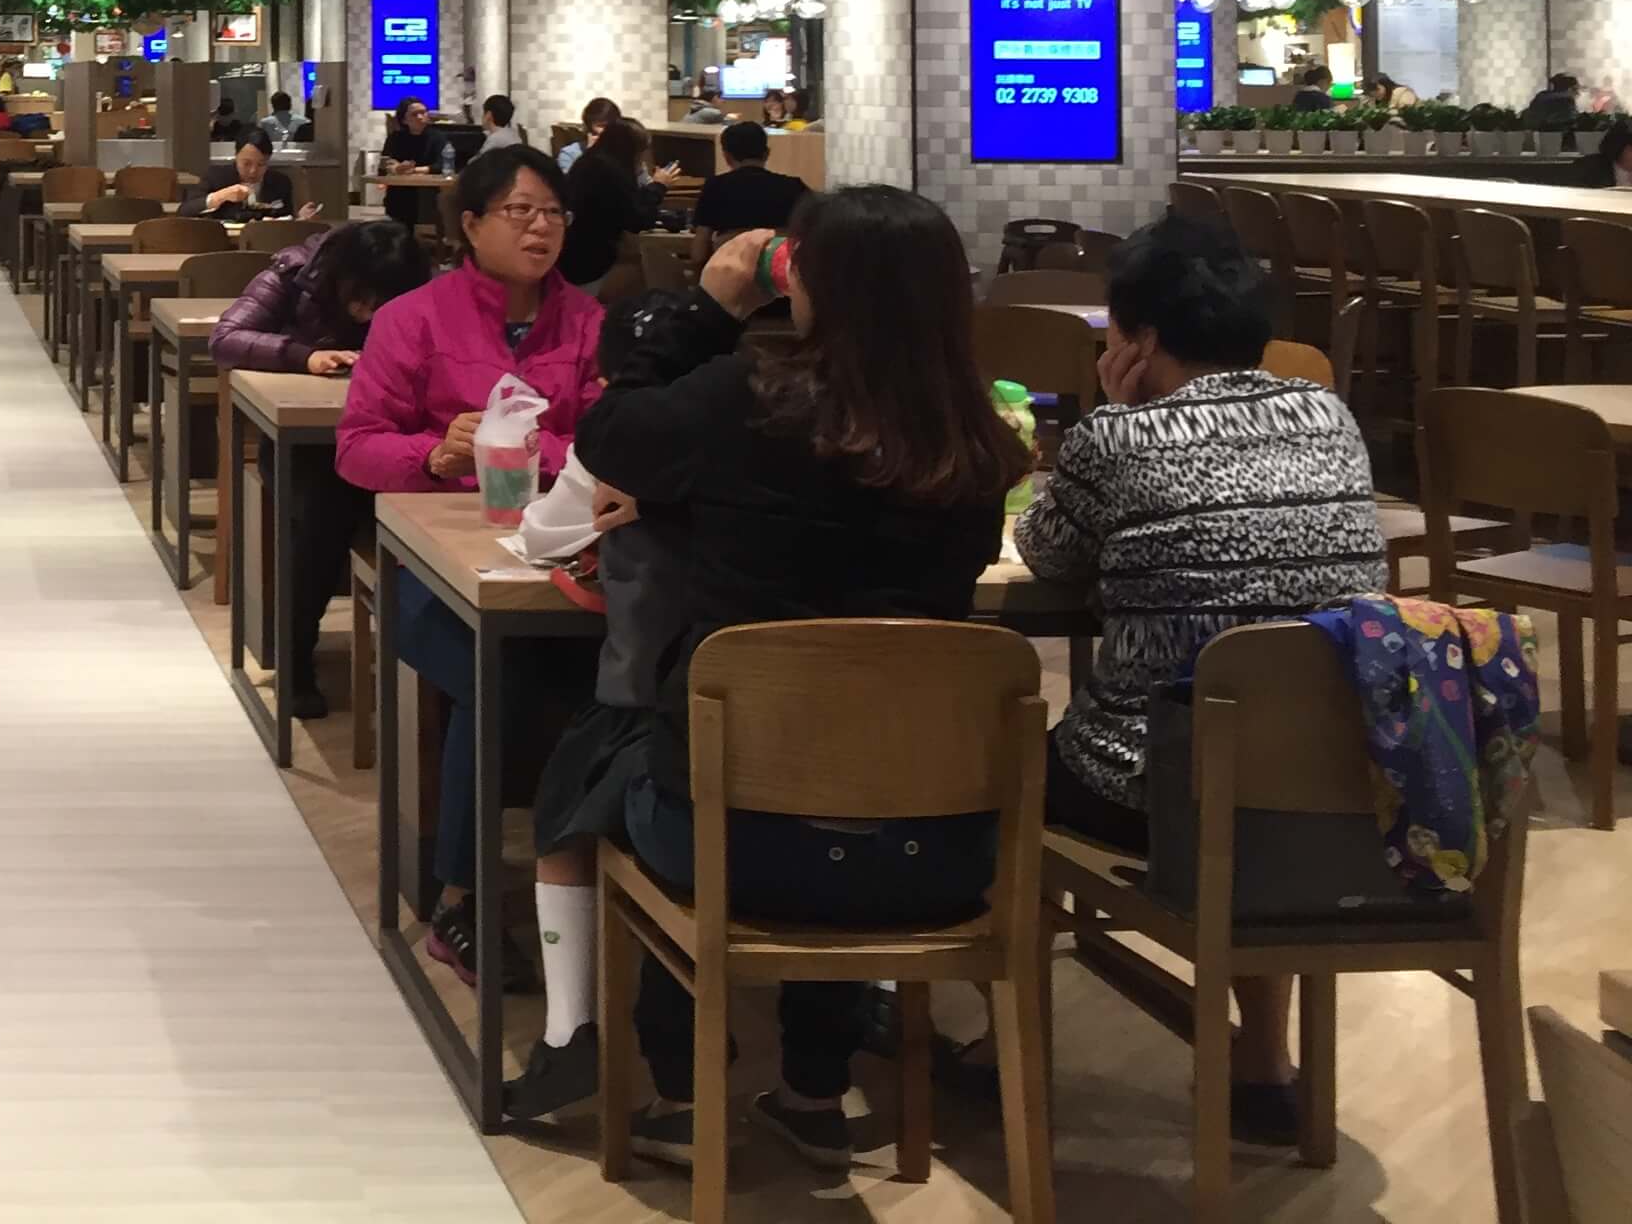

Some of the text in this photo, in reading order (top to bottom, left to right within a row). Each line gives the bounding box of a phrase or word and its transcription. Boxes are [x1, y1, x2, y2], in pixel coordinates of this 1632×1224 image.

[1024, 0, 1044, 9] not
[384, 18, 428, 36] C2
[1177, 22, 1200, 39] 2
[996, 87, 1098, 103] 02 2739 9308
